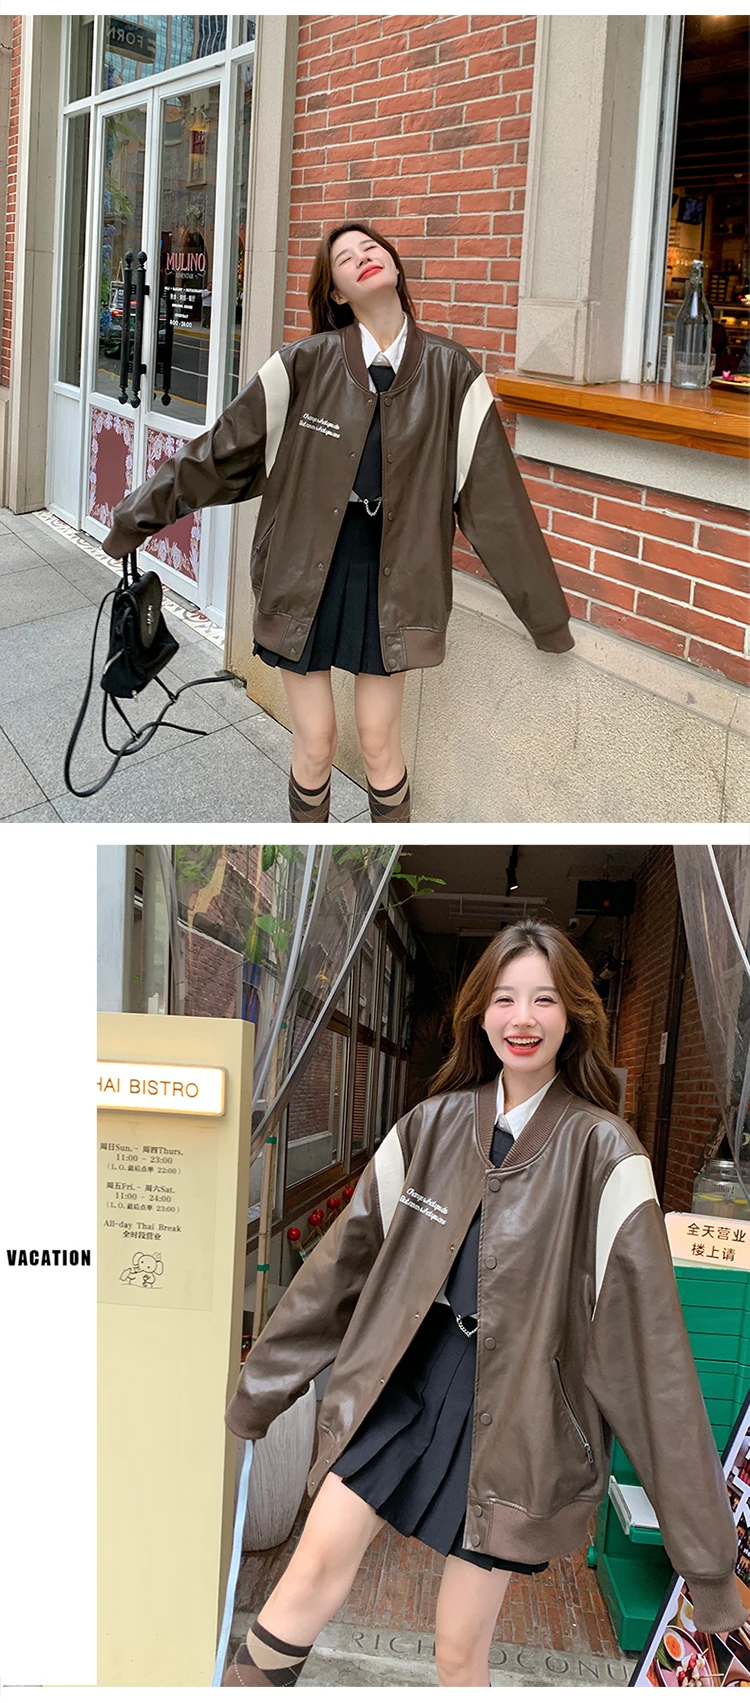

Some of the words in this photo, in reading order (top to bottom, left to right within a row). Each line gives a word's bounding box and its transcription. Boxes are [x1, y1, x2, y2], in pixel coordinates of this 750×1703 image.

[166, 252, 206, 272] MULINO
[130, 1079, 199, 1098] BISTRO
[116, 1154, 138, 1162] 11:00
[150, 1156, 173, 1164] 23:00
[116, 1192, 138, 1200] 11:00
[149, 1194, 172, 1202] 24:00
[104, 1220, 132, 1230] All-day
[136, 1222, 154, 1230] Thai
[158, 1224, 182, 1232] Break
[687, 1222, 746, 1243] 全天营业
[123, 1230, 162, 1240] 全时段营业
[691, 1243, 736, 1262] 楼上请
